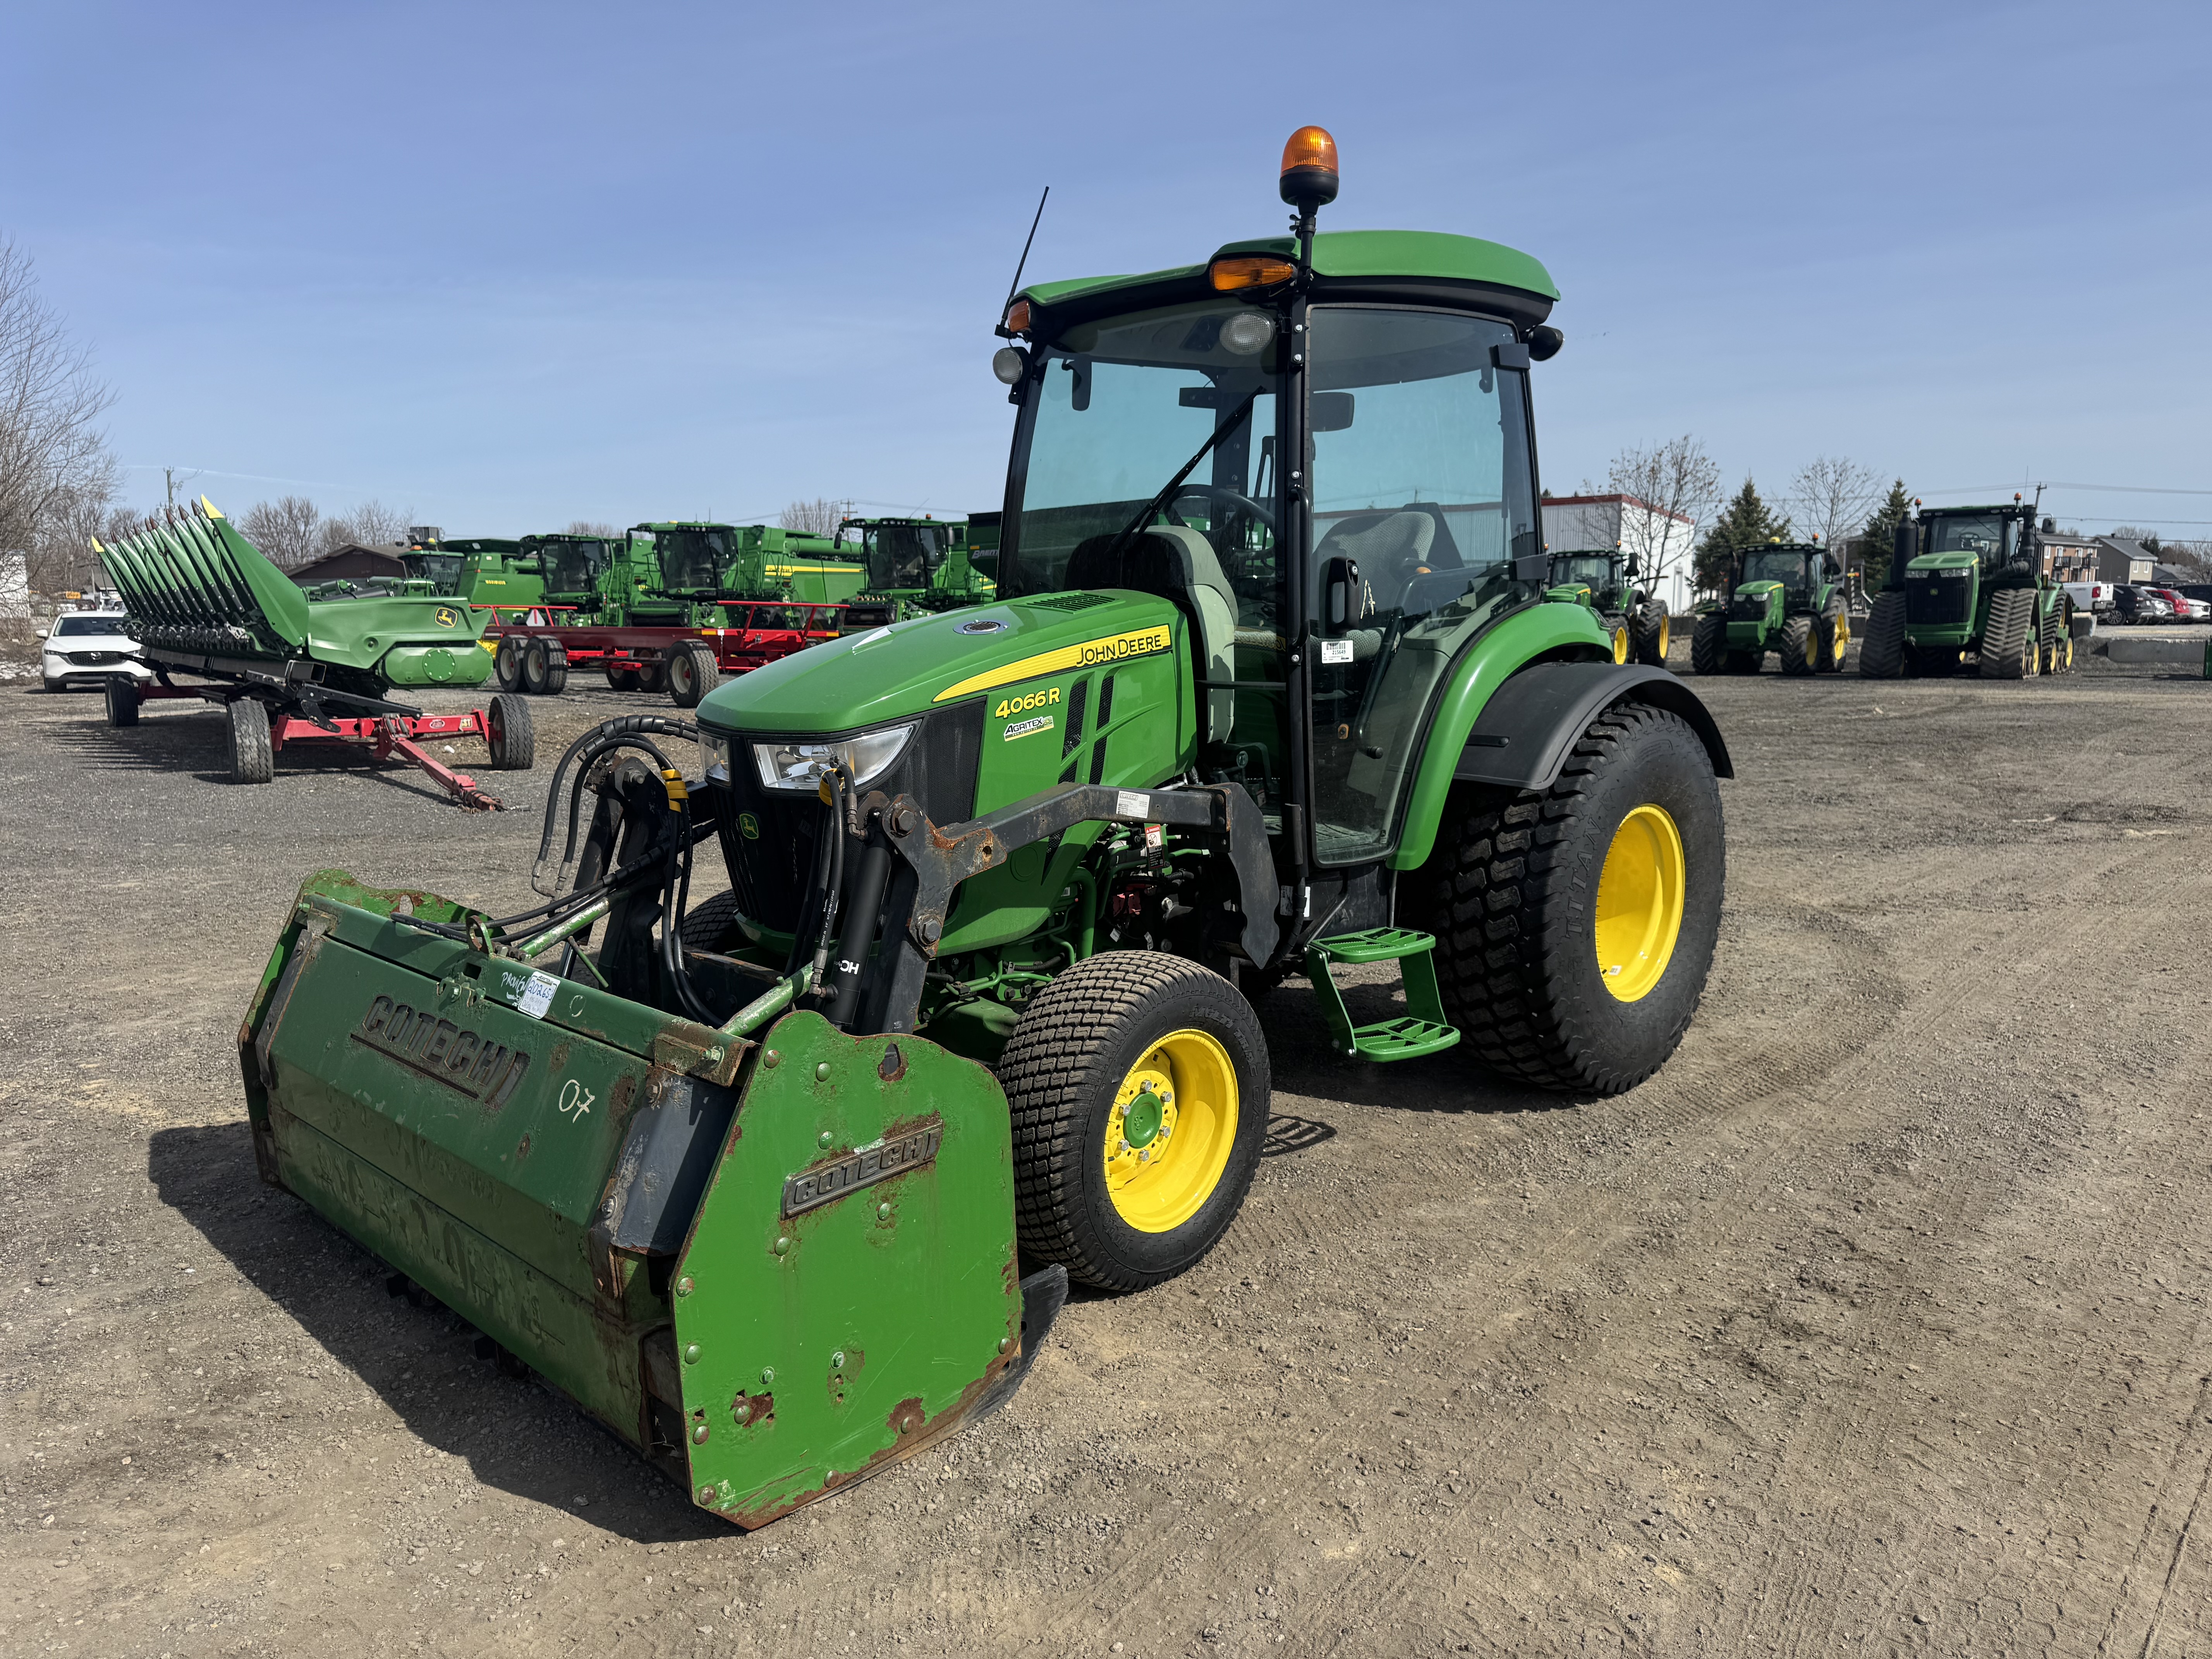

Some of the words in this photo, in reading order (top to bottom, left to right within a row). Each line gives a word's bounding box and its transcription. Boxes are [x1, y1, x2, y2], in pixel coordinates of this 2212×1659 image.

[1077, 644, 1116, 665] JOHN
[1118, 634, 1161, 655] DEERE
[996, 687, 1060, 718] 4066R
[1005, 718, 1042, 734] AGRITEX
[1565, 814, 1601, 939] TITAN
[559, 1079, 595, 1123] 07
[794, 1134, 924, 1204] COTECH
